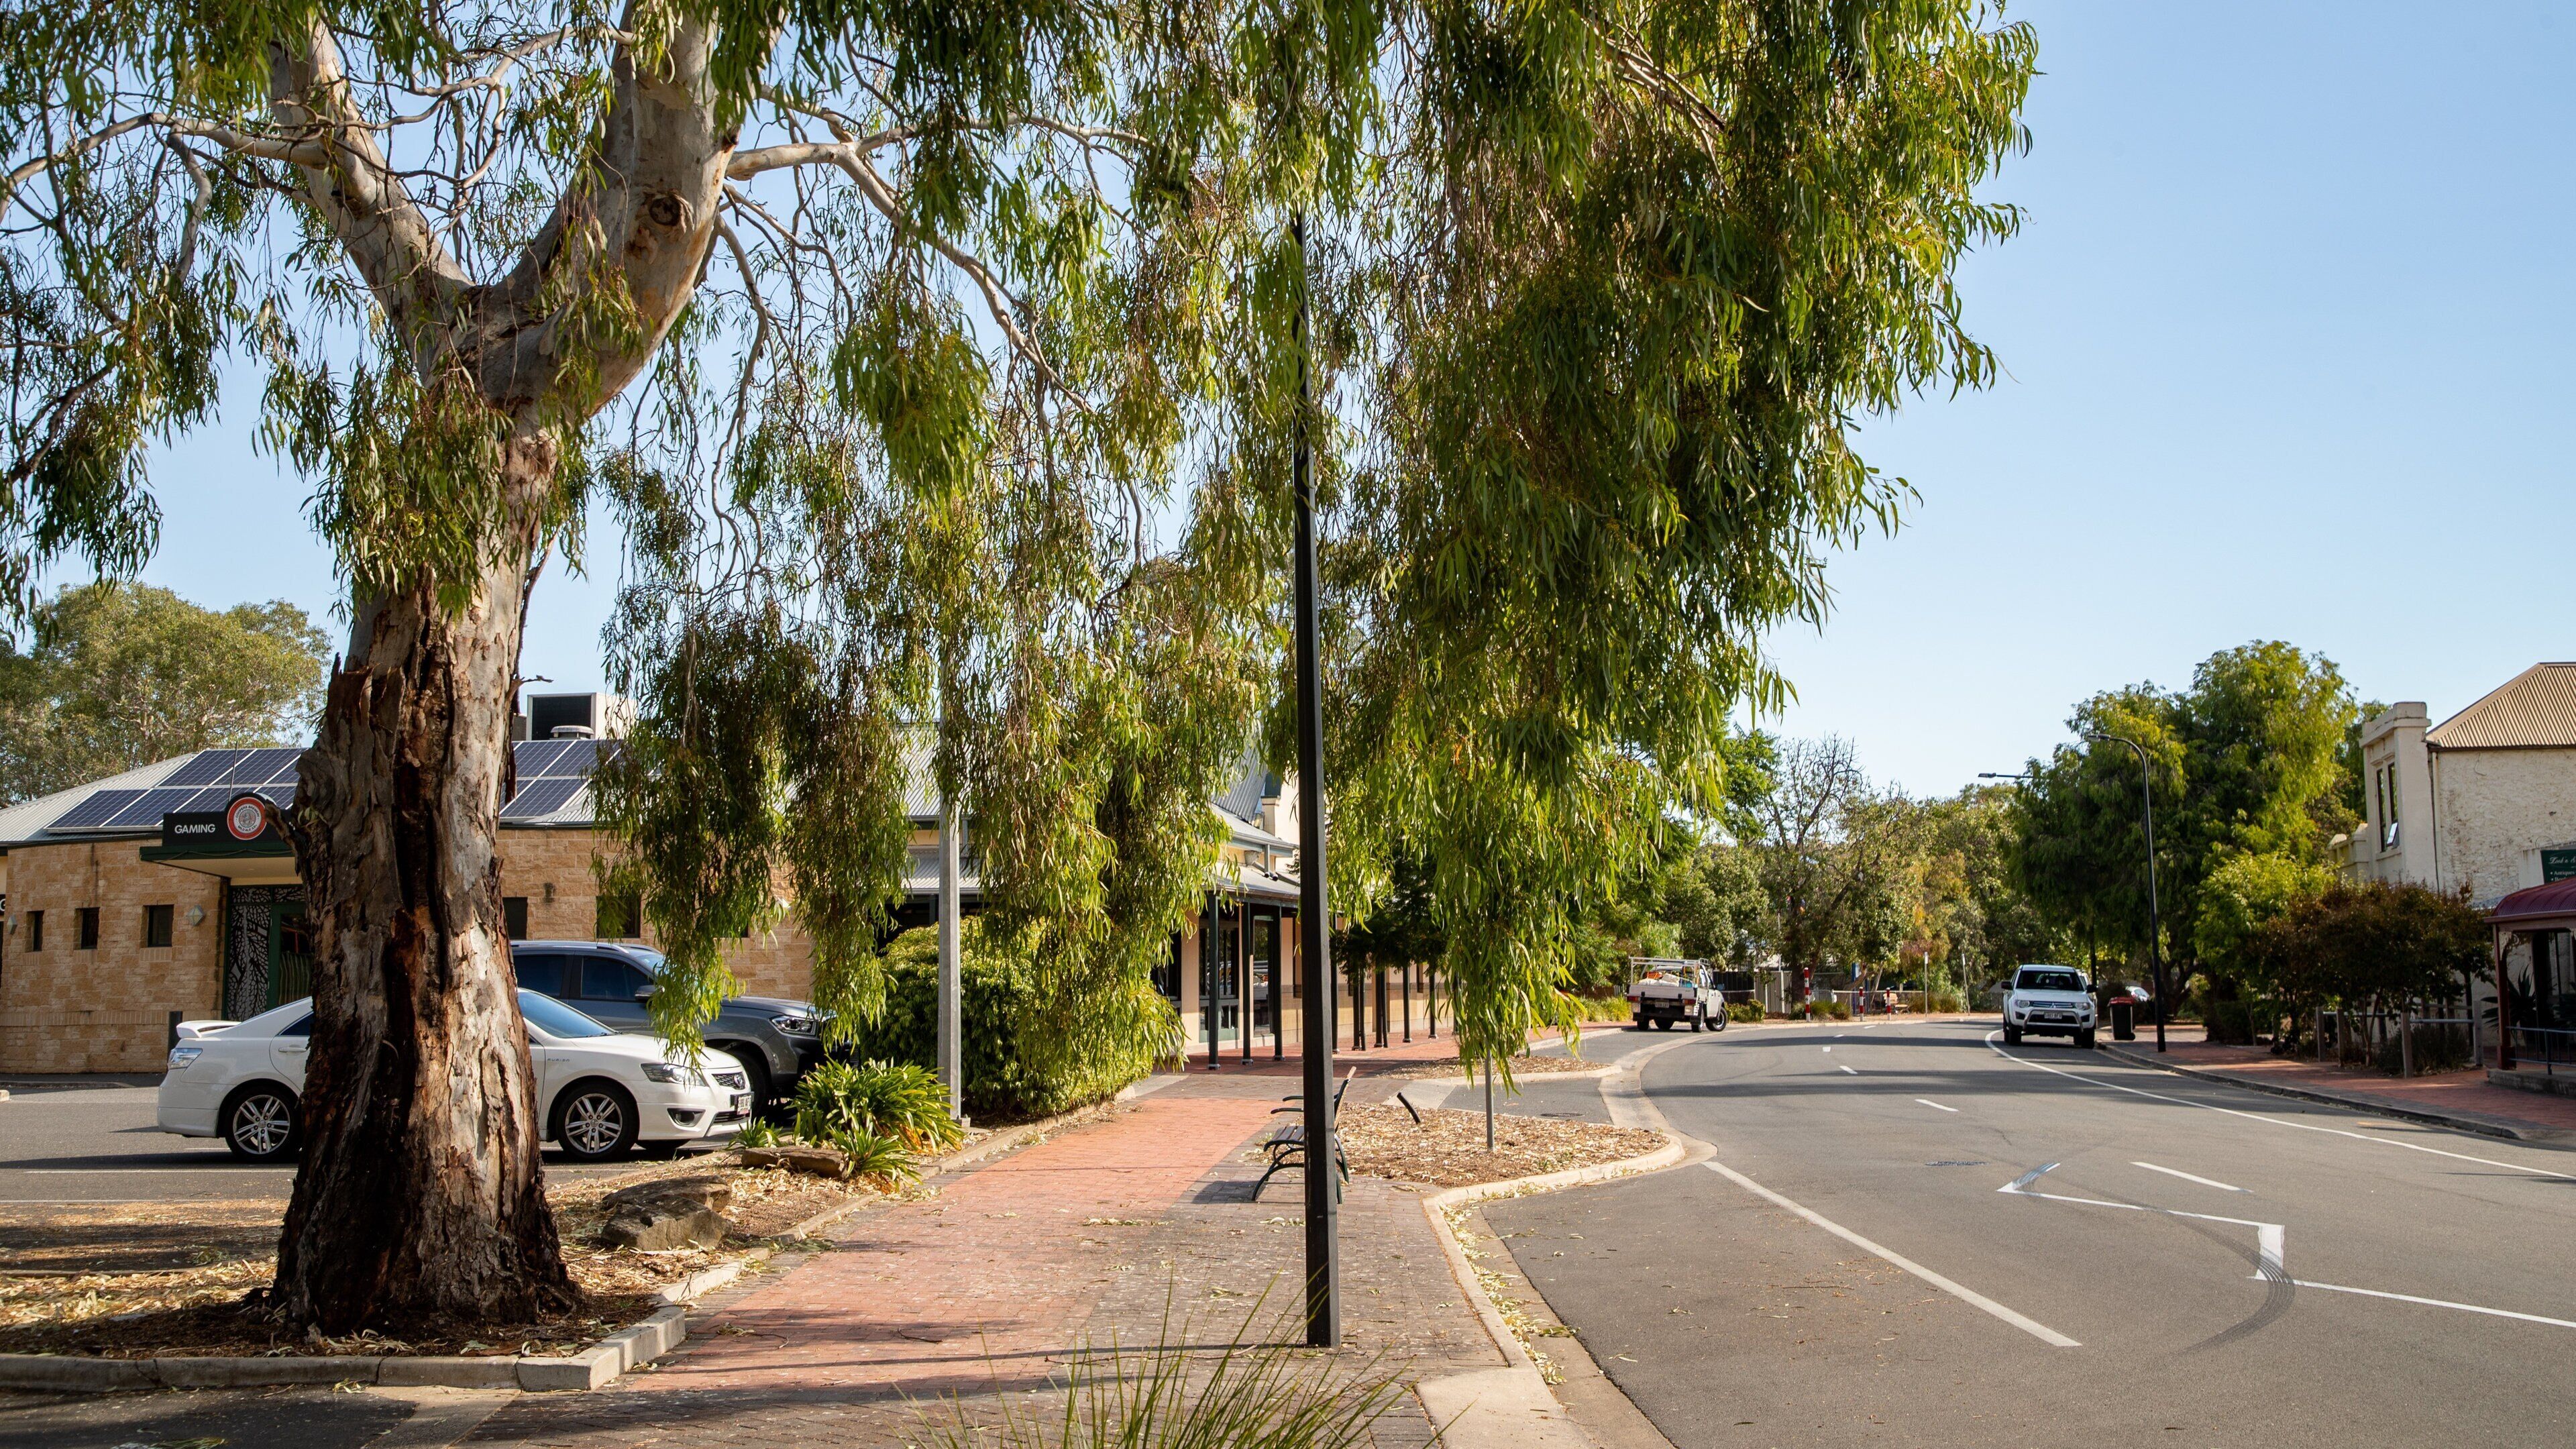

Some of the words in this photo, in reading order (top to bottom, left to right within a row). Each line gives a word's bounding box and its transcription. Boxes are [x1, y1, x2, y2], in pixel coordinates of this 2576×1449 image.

[235, 806, 248, 818] COOPERS
[248, 806, 260, 817] BREWERY
[174, 824, 215, 833] GAMING
